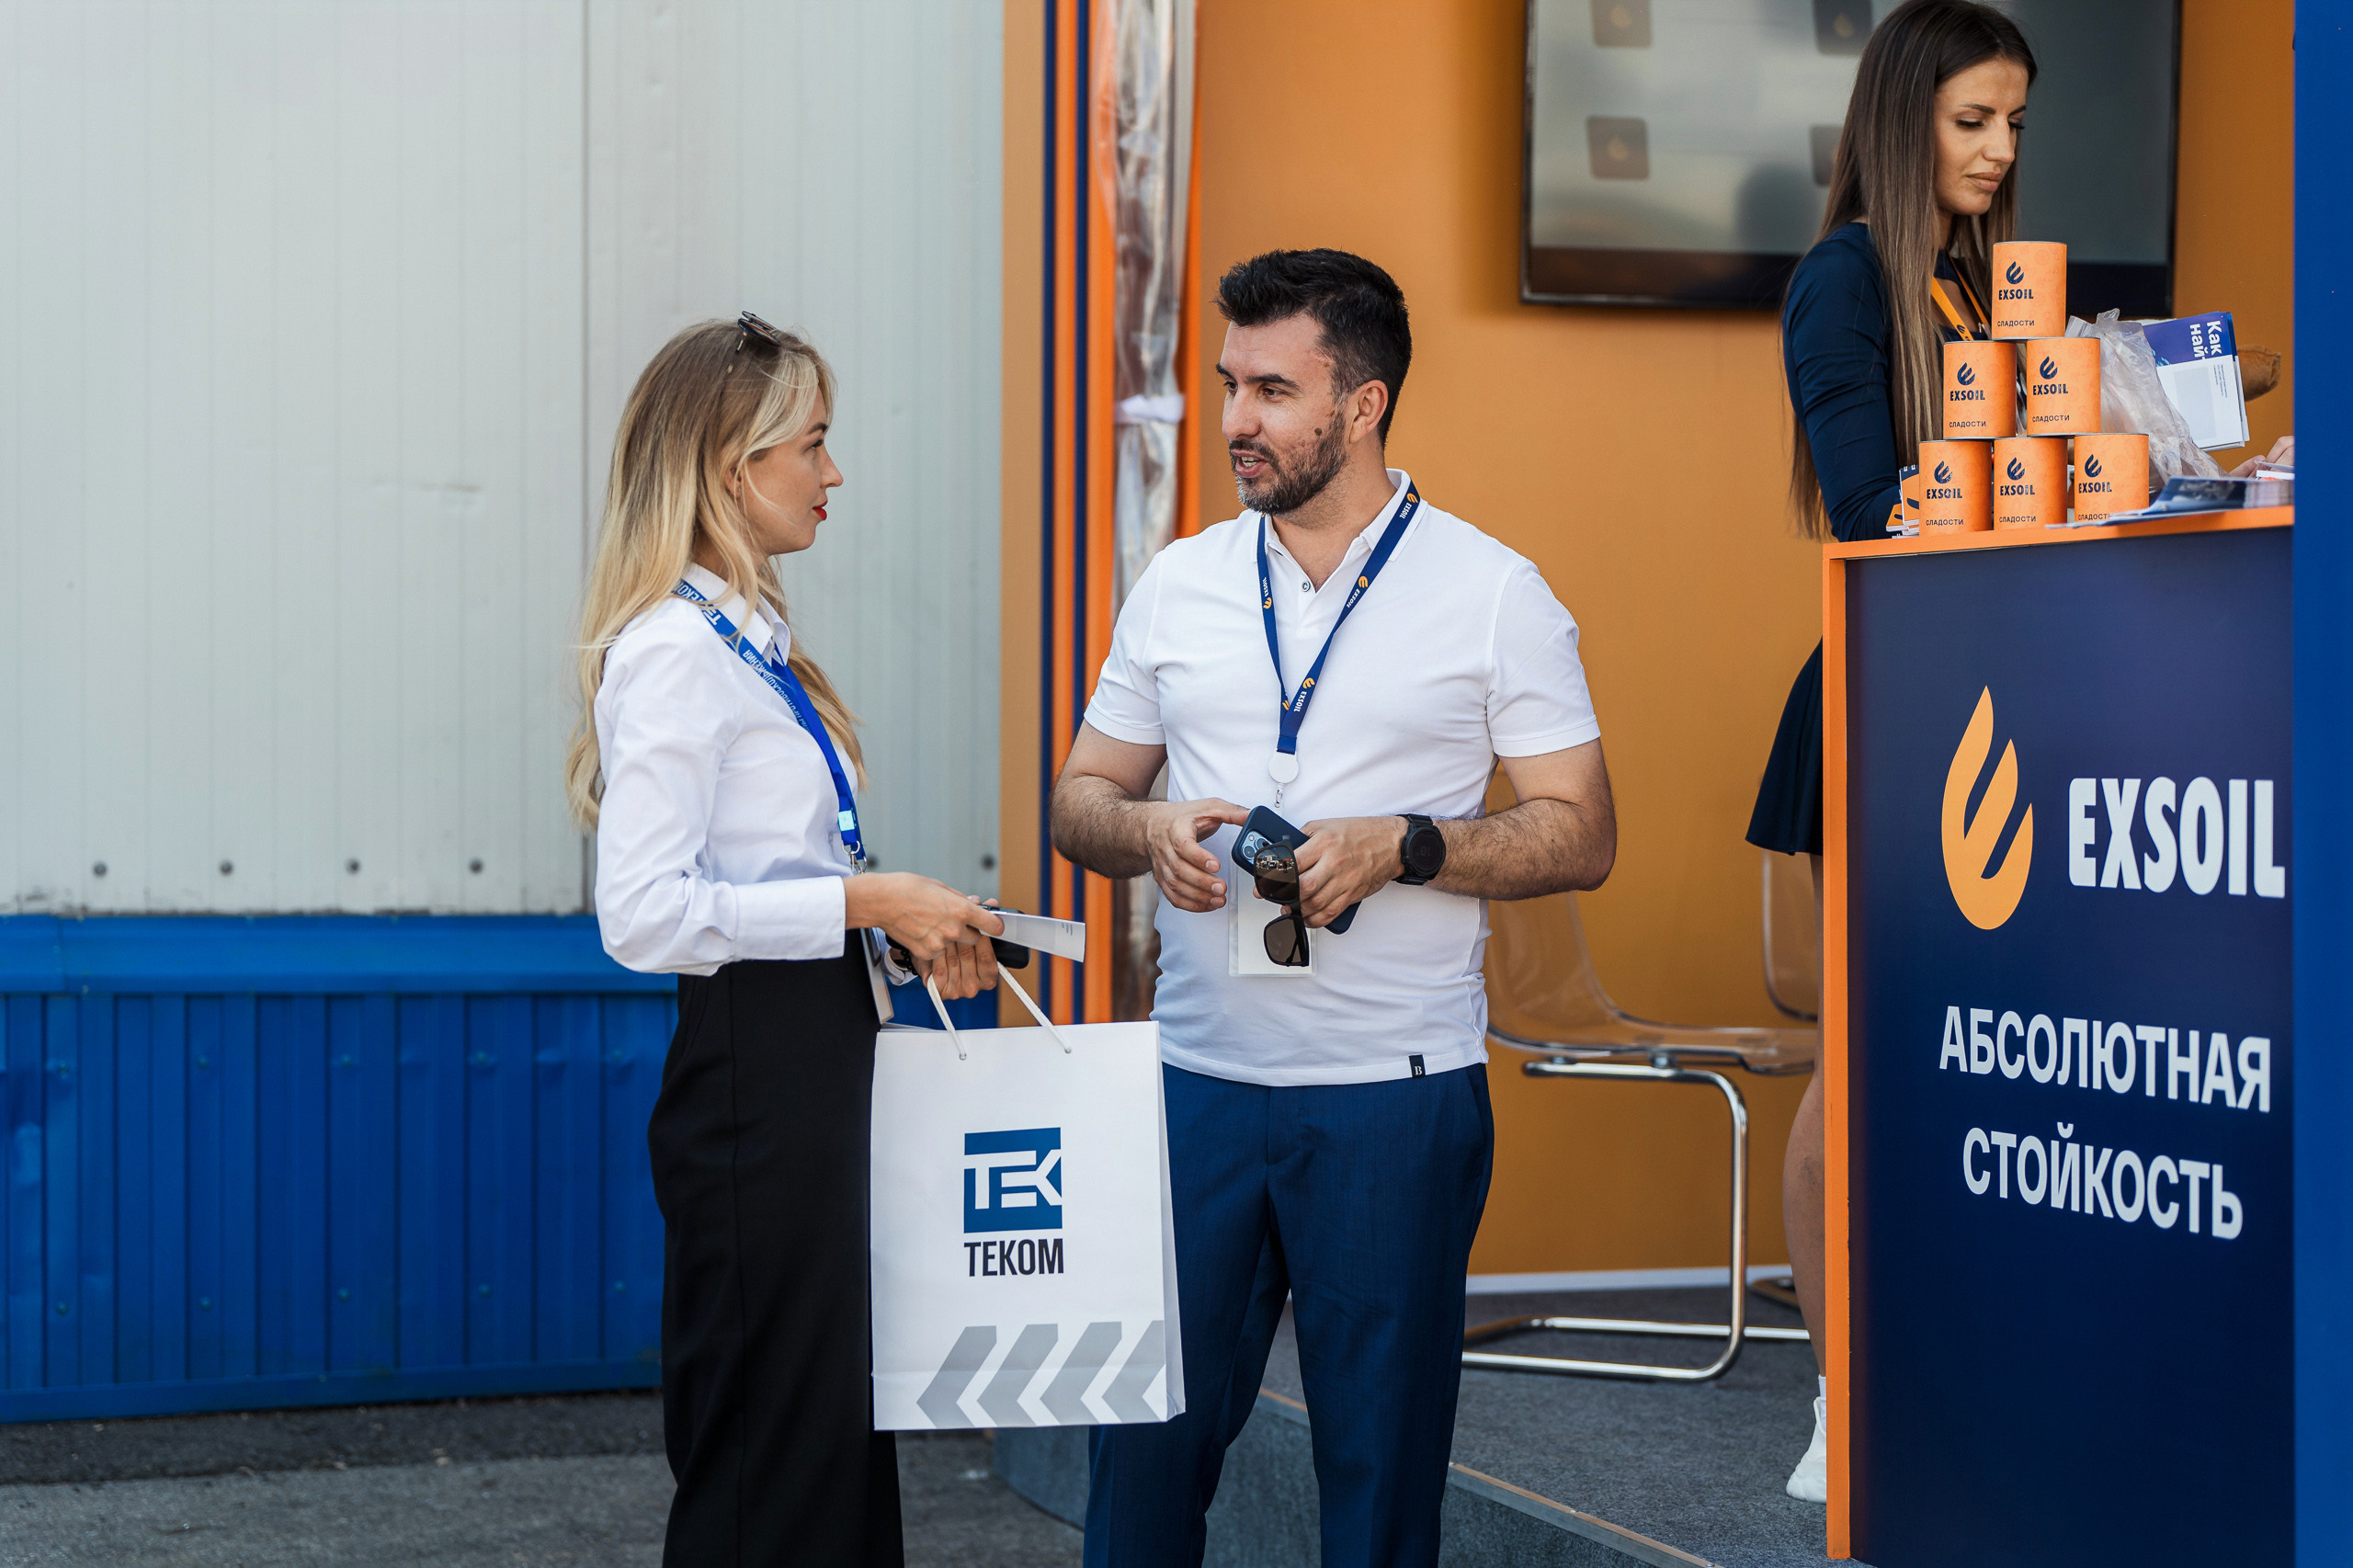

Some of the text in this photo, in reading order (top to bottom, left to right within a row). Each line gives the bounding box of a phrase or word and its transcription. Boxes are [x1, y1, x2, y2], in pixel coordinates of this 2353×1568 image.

[1998, 289, 2034, 301] EXSOIL
[1997, 319, 2035, 327] СЛАДОСТИ
[2207, 320, 2222, 356] Как
[1949, 389, 1985, 402] EXSOIL
[2032, 383, 2069, 396] EXSOIL
[1949, 420, 1987, 428] СЛАДОСТИ
[2032, 415, 2070, 423] СЛАДОСТИ
[1926, 487, 1963, 499] EXSOIL
[1999, 484, 2036, 496] EXSOIL
[2078, 482, 2113, 494] EXSOIL
[1399, 502, 1413, 519] EXSOIL
[1926, 518, 1964, 527] СЛАДОСТИ
[1998, 515, 2037, 523] СЛАДОСТИ
[1293, 690, 1308, 712] EXSOIL
[2068, 776, 2286, 899] EXSOIL
[1938, 1006, 2271, 1113] АБСОЛЮТНАЯ
[1962, 1121, 2244, 1241] СТОЙКОСТЬ
